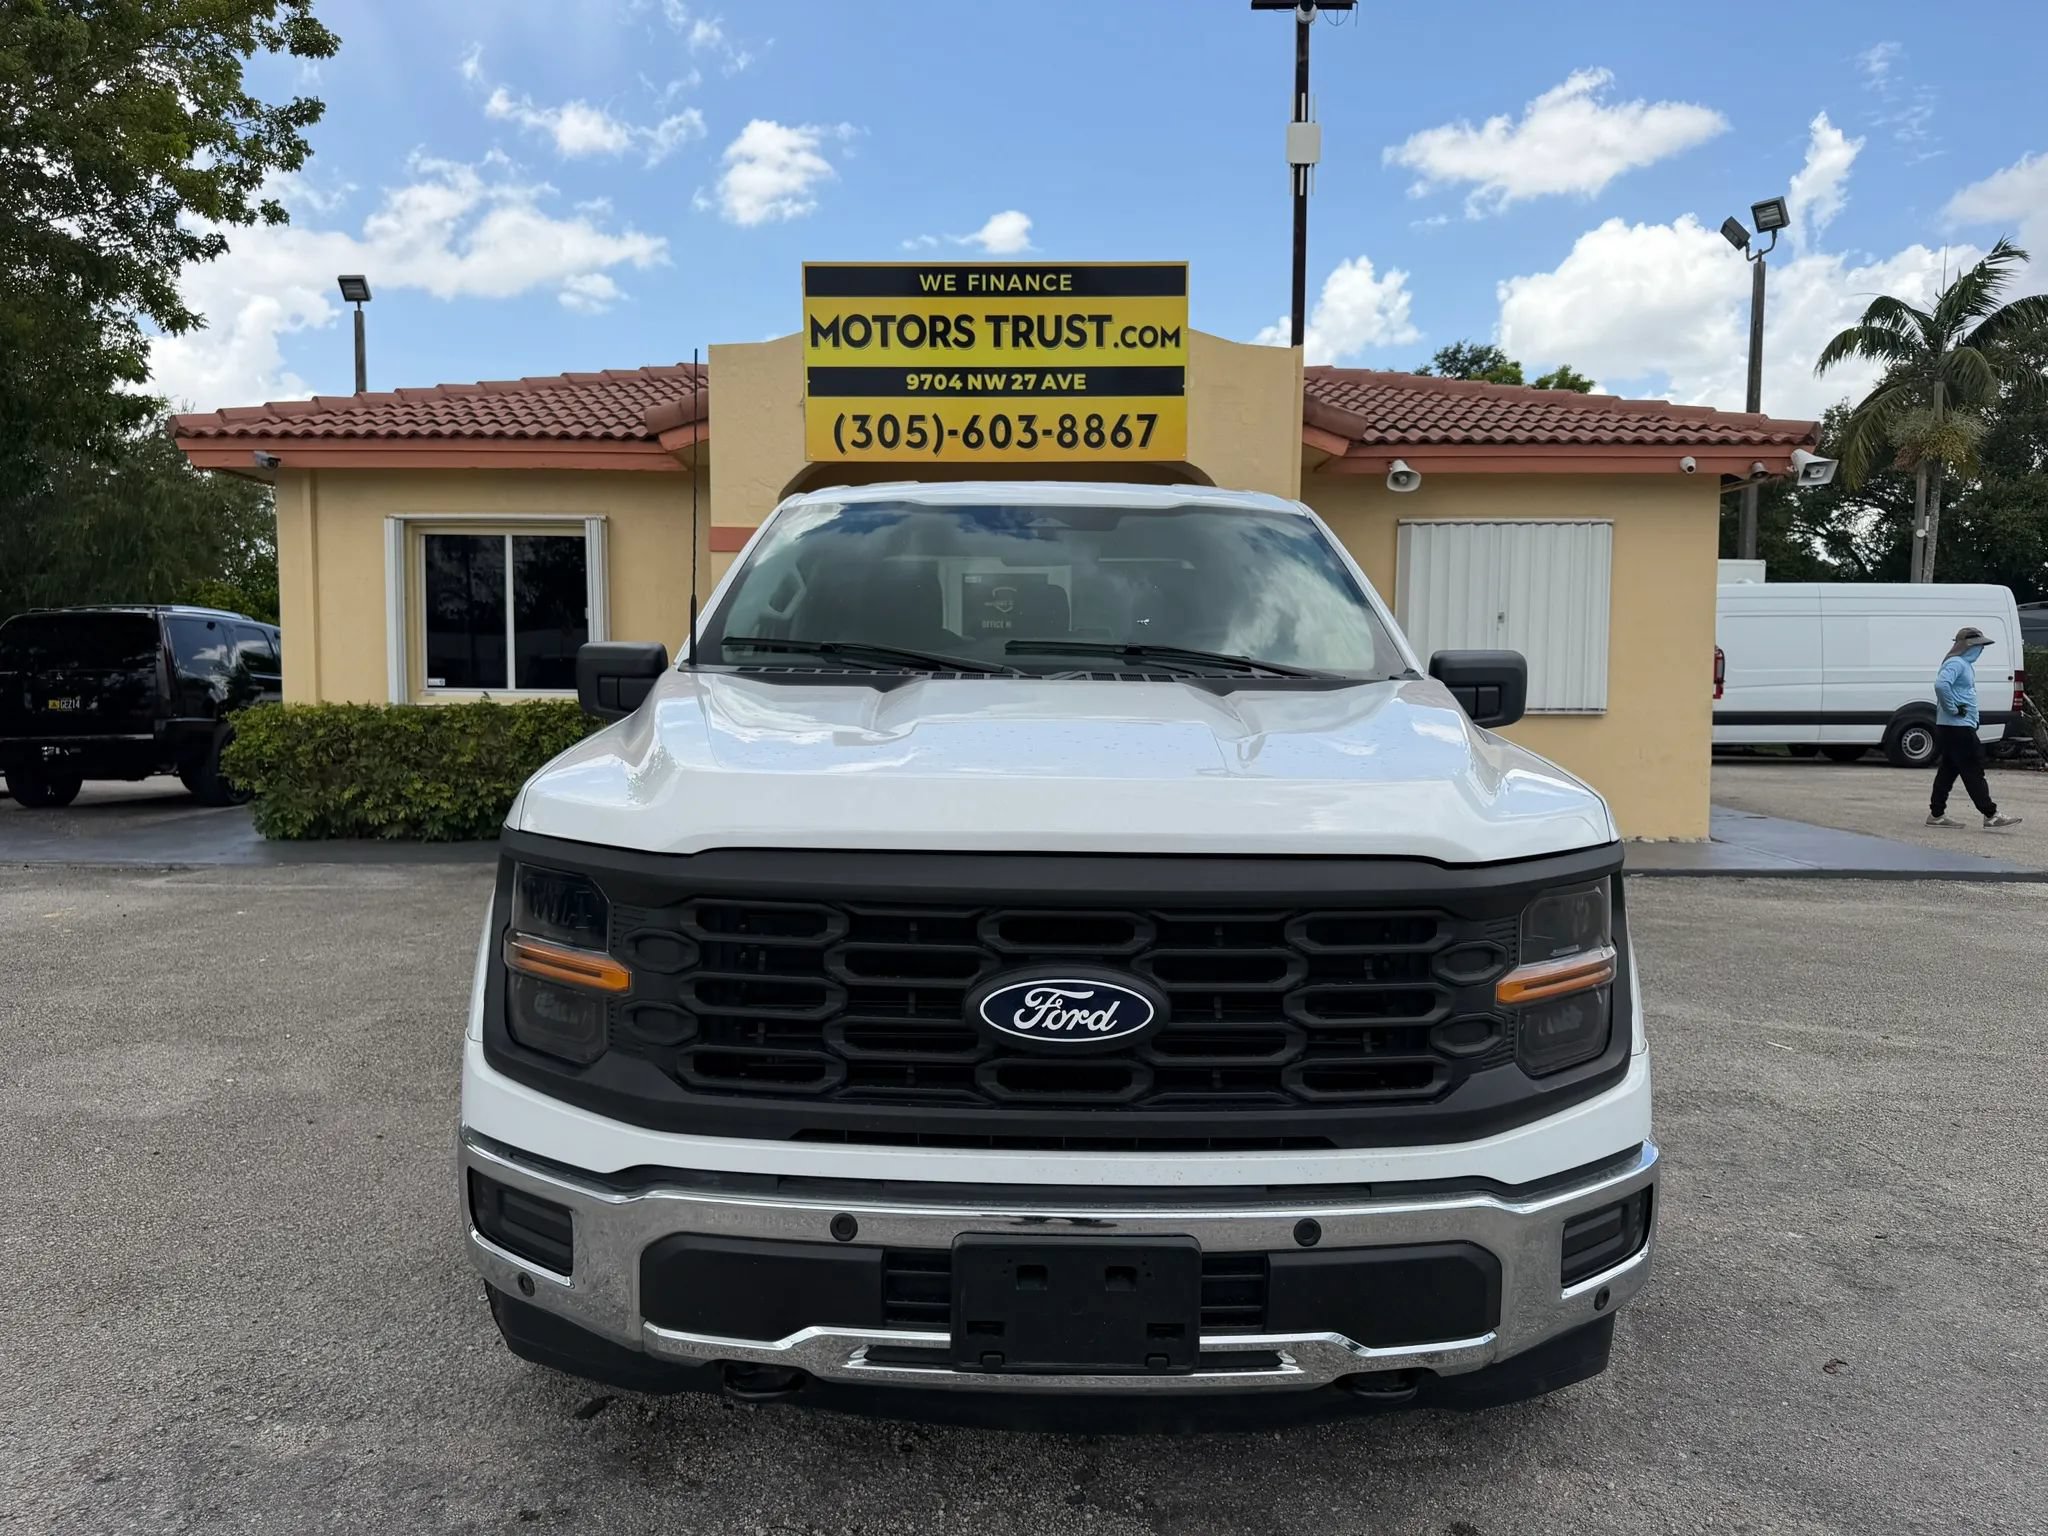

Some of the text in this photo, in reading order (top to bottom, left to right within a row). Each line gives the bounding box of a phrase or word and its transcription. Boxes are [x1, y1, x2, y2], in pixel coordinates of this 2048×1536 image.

[919, 273, 1073, 291] WE FINANCE
[809, 313, 976, 349] MOTORS
[906, 374, 1086, 390] 9704 NW 27 AVE
[833, 412, 1159, 456] (305)-603-8867
[1013, 987, 1120, 1032] Ford
